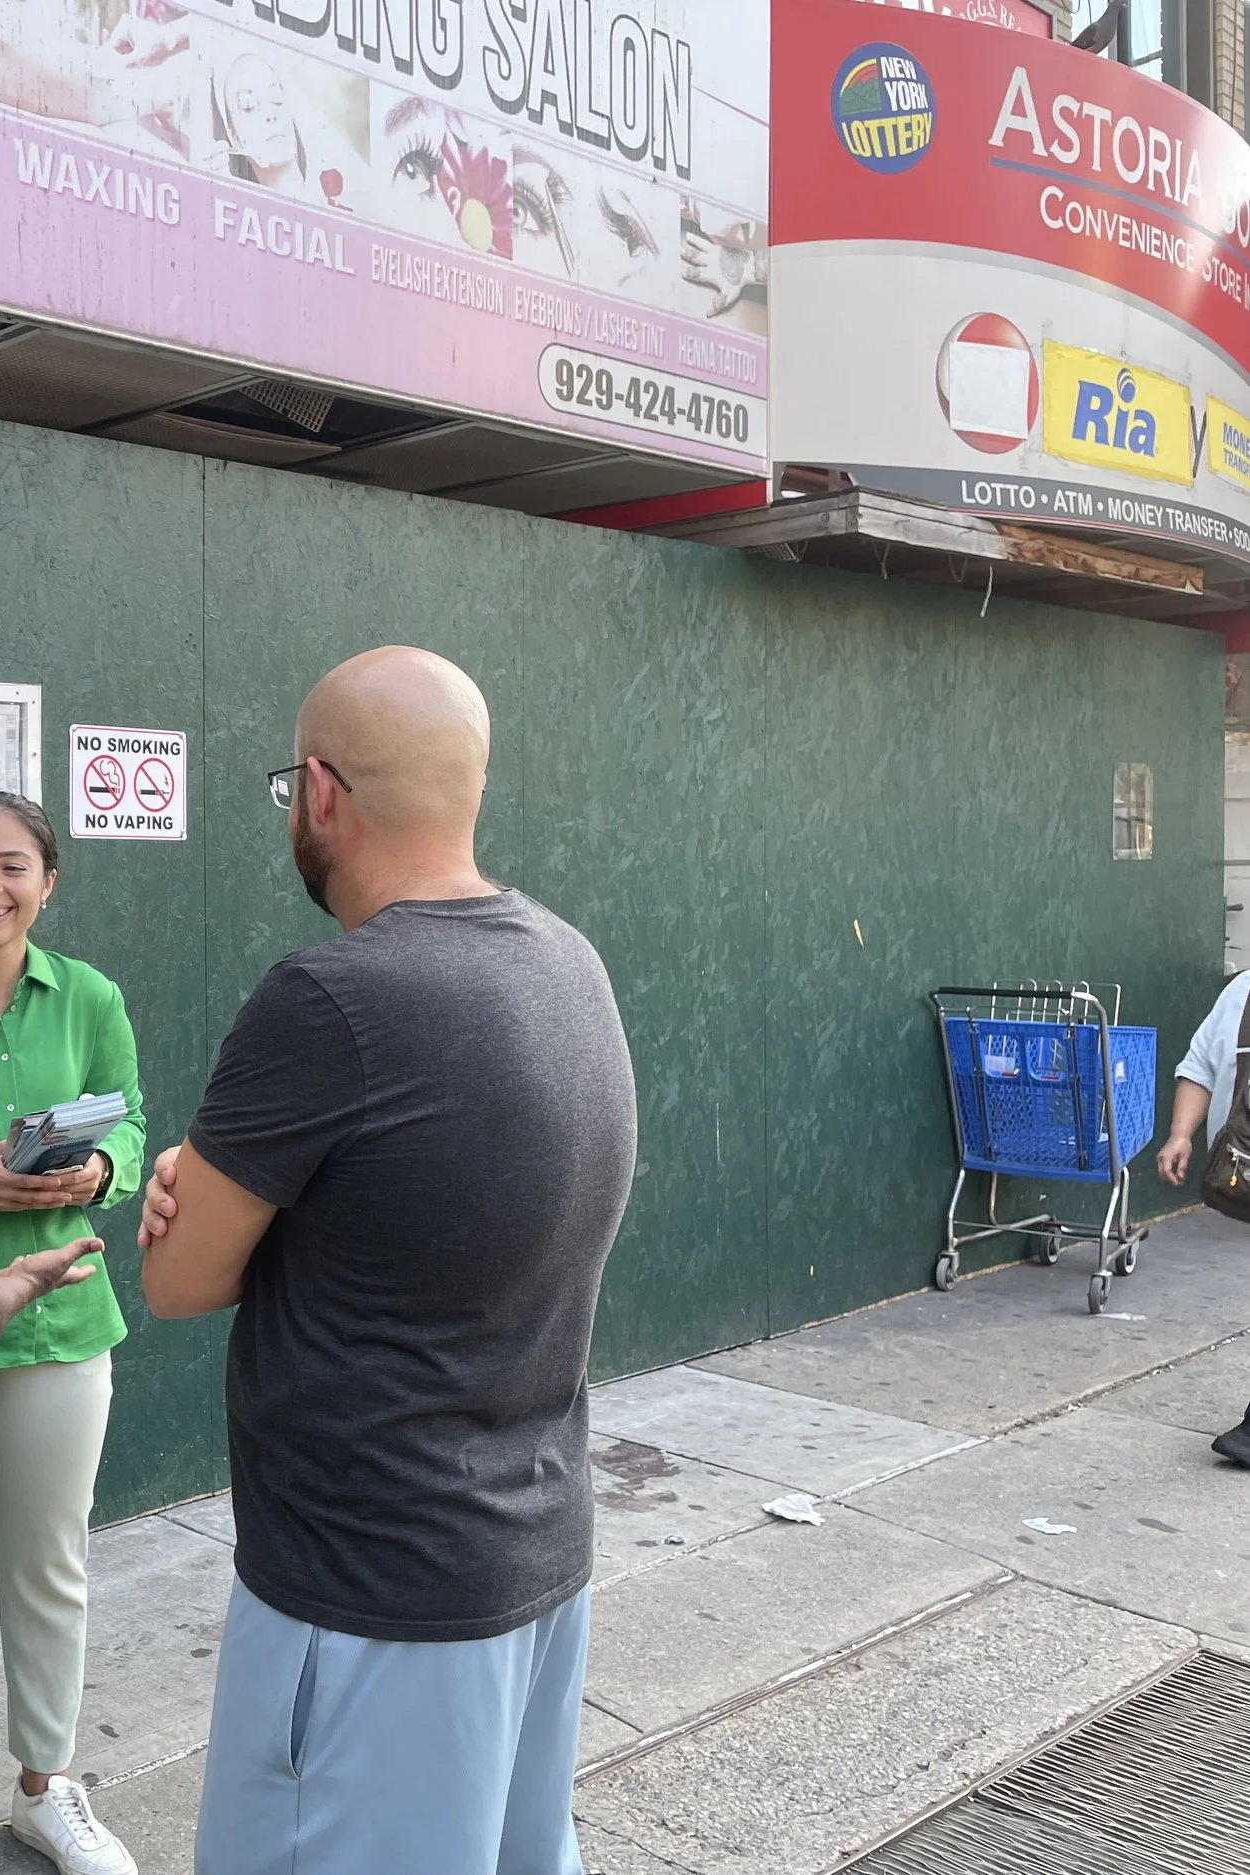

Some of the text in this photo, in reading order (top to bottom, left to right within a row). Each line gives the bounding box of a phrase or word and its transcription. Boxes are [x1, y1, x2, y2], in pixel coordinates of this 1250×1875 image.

[482, 0, 691, 181] SALON
[880, 56, 917, 80] NEW
[884, 80, 929, 112] YORK
[841, 112, 932, 158] LOTTERY
[988, 66, 1203, 207] ASTORIA
[13, 138, 181, 225] WAXING
[214, 197, 356, 275] FACIAL
[371, 243, 432, 296] EYELASH
[434, 262, 505, 316] EXTENSION
[515, 285, 583, 337] EYEBROWS
[594, 309, 639, 351] LASHES
[640, 322, 666, 359] TINT
[678, 331, 716, 371] HENNA
[717, 343, 758, 385] TATTOO
[1039, 186, 1195, 272] CONVENIENCE
[1201, 251, 1242, 304] STORE
[554, 358, 749, 443] 929-424-4760
[1072, 368, 1157, 458] Ria
[961, 480, 1035, 509] LOTTO
[1053, 489, 1093, 516] ATM
[1108, 497, 1163, 527] MONEY
[1165, 507, 1229, 544] TRANSFER
[77, 735, 181, 756] NO SMOKING
[85, 813, 173, 830] NO VAPING
